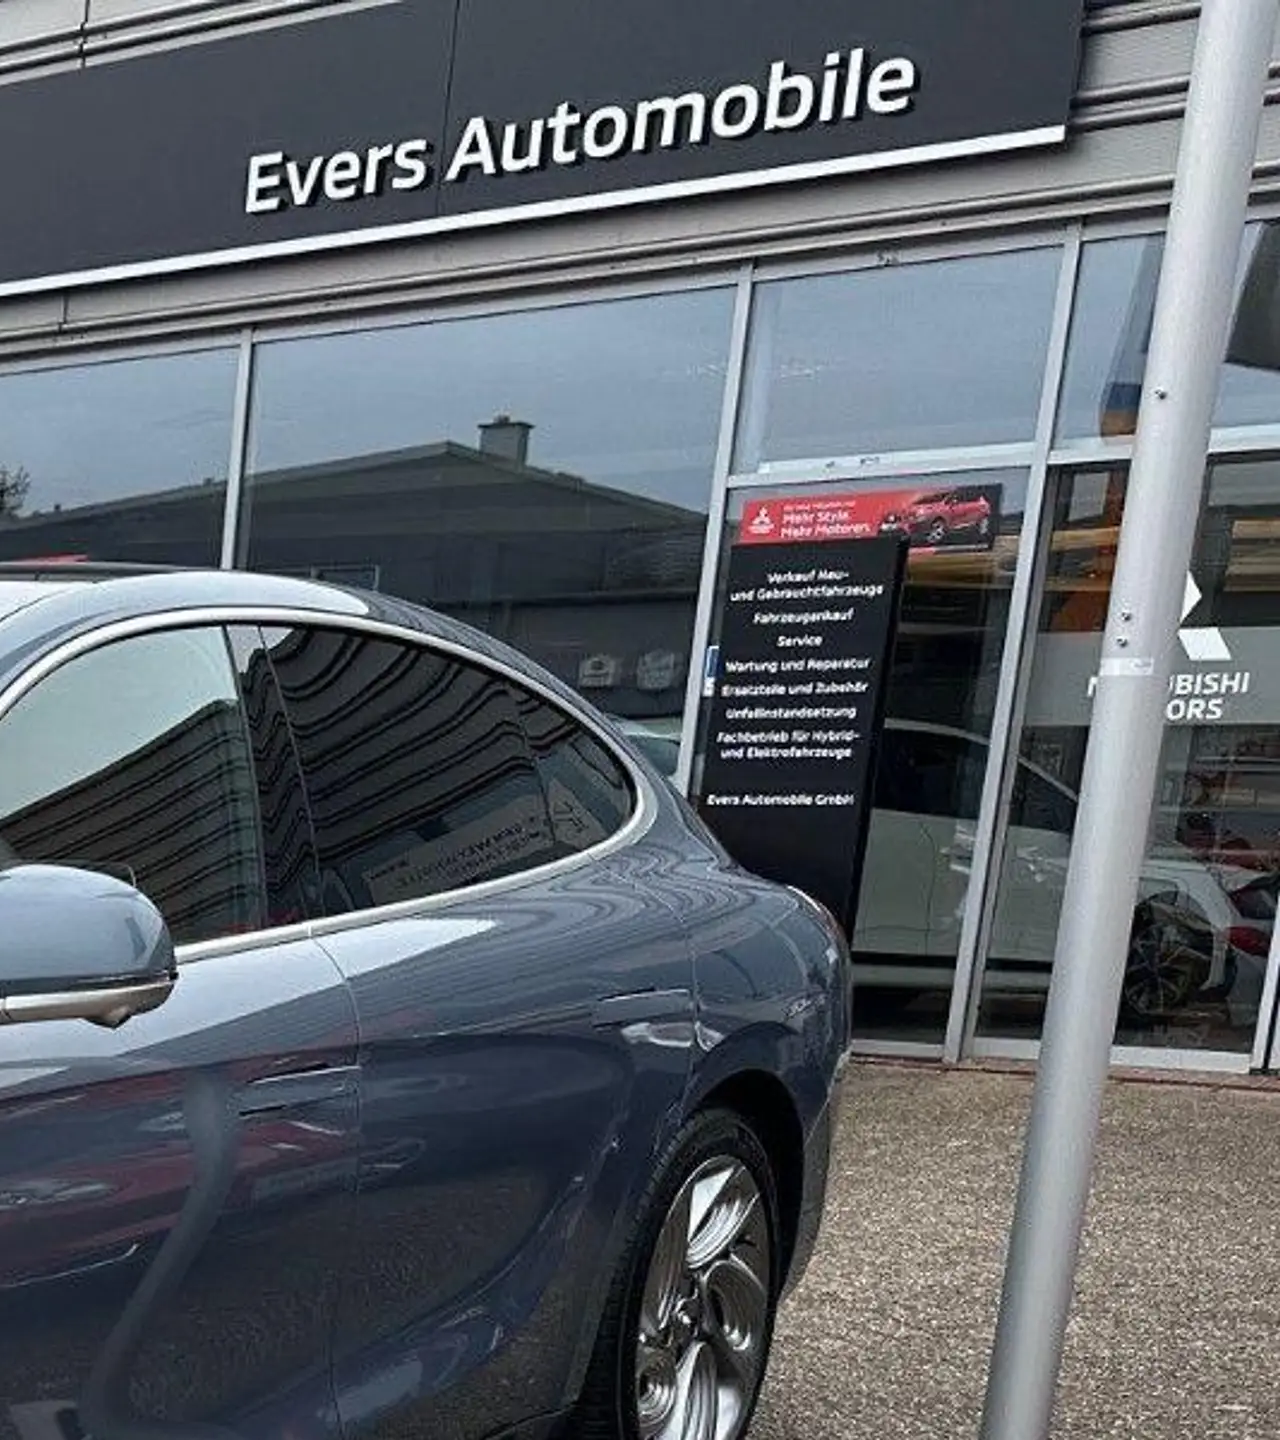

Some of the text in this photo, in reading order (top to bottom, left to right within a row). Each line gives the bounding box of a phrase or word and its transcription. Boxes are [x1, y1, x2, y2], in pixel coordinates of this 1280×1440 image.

[245, 47, 916, 213] Evers Automobile
[768, 568, 849, 583] Verkauf Neu-
[730, 585, 884, 601] und Gebrauchtfahrzeuge
[753, 607, 855, 625] Fahrzeugankauf
[776, 635, 823, 647] Service
[725, 658, 871, 673] Wartung und Reparatur
[721, 680, 869, 697] Ersatzteile und Zubehör
[725, 707, 857, 720] Unfallinstandsetzung
[1166, 698, 1223, 720] ORS
[716, 730, 860, 744] Fachbetrieb für Hybrid-
[720, 747, 852, 760] und Elektrofahrzeuge
[706, 793, 854, 805] Evers Automobile GmbH
